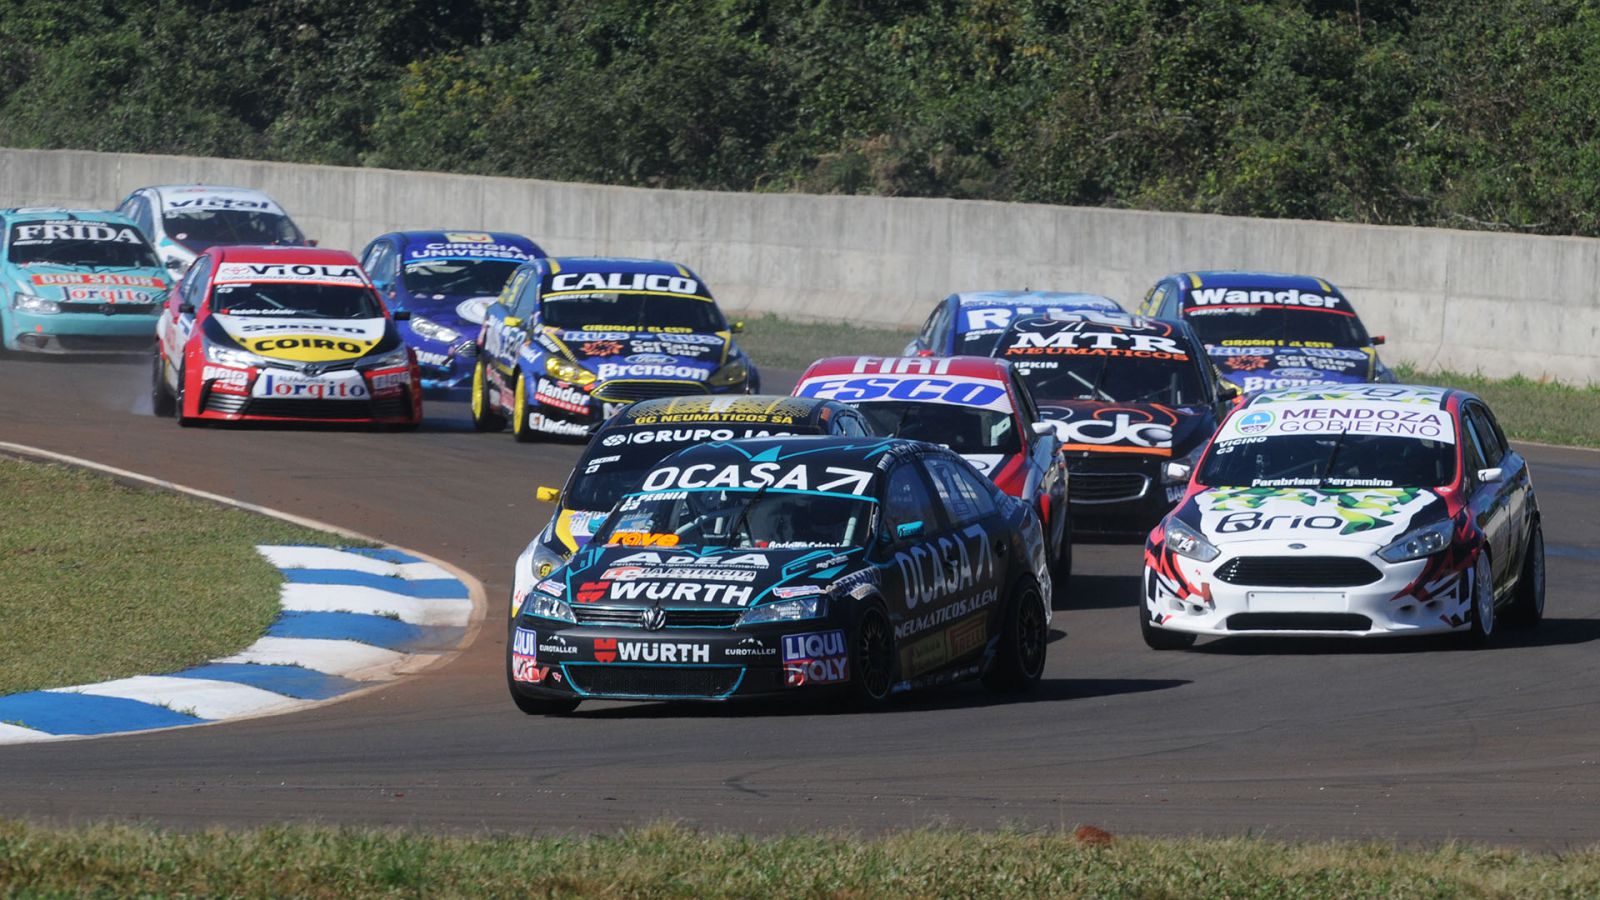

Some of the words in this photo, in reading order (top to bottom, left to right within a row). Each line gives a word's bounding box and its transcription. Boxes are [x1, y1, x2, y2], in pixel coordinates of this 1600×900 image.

[15, 224, 142, 244] FRIDA
[426, 243, 523, 253] CIRUGIA
[551, 272, 698, 295] CALICO
[1190, 287, 1341, 309] Wander
[254, 338, 362, 354] COIRO
[1009, 331, 1186, 355] MTR
[1005, 346, 1190, 362] NEUMATICOS
[597, 363, 710, 381] Brenson
[853, 356, 962, 375] FIAT
[1012, 361, 1059, 369] IPKIN
[263, 374, 365, 400] Jorgito
[537, 378, 590, 406] Wander
[770, 414, 793, 424] SA
[1282, 408, 1443, 426] MENDOZA
[632, 429, 734, 444] GRUPO
[1279, 420, 1441, 437] GOBIERNO
[1218, 437, 1268, 449] VICINO
[641, 462, 808, 492] OCASA
[1251, 478, 1321, 488] Parabrisas
[1215, 511, 1343, 534] Brio
[894, 532, 973, 610] OCASA
[609, 581, 753, 606] WÜRTH
[617, 641, 710, 663] WÜRTH
[725, 648, 776, 656] EUROTALLER
[785, 632, 844, 660] LIQUI
[788, 656, 847, 683] MOLY
